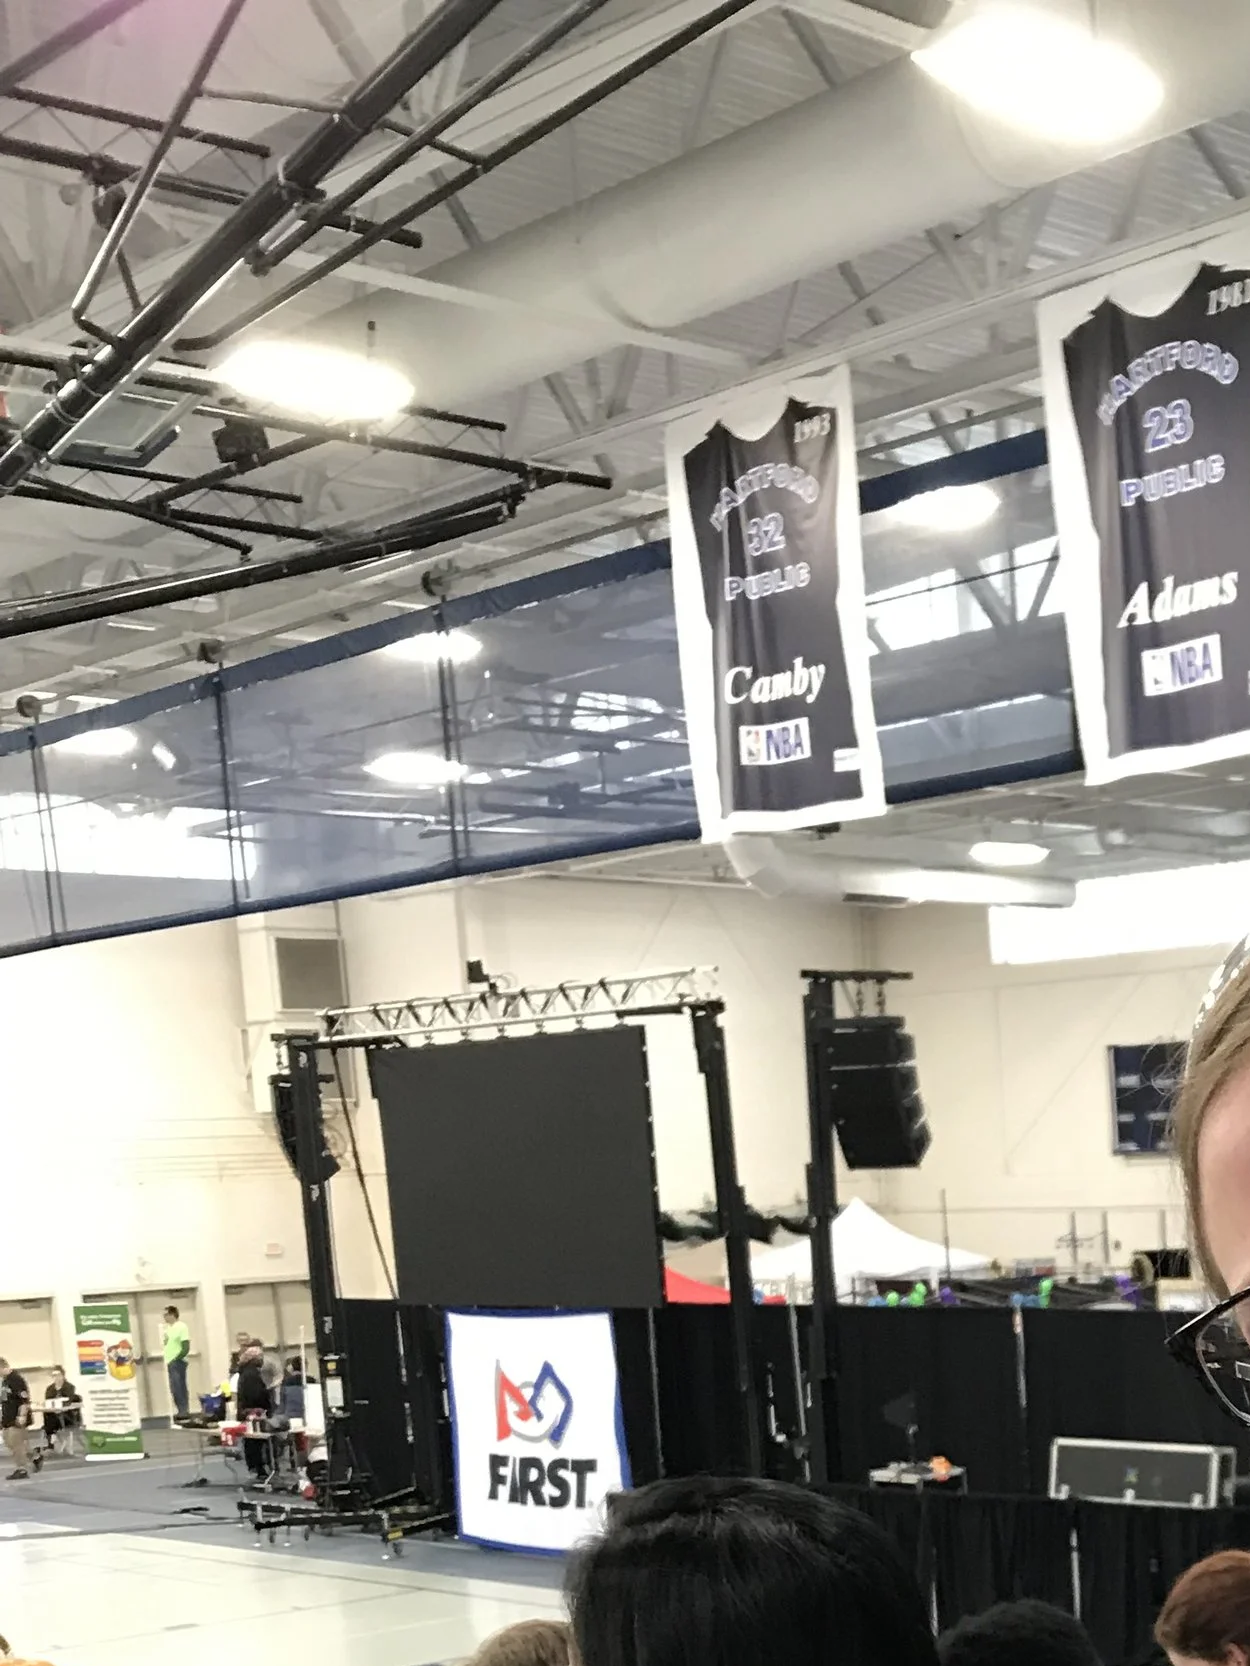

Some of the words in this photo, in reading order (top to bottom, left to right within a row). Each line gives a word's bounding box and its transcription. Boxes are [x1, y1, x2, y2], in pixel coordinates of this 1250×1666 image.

[1096, 339, 1240, 426] HARTFORD
[1142, 398, 1195, 453] 23
[709, 462, 820, 533] HARTFORD
[1118, 454, 1227, 507] PUBLIC
[747, 511, 787, 556] 32
[723, 561, 812, 601] PUBLIC
[1115, 571, 1239, 629] Adams
[724, 656, 826, 704] Camby
[1169, 642, 1214, 687] NBA
[765, 723, 804, 761] NBA
[488, 1453, 597, 1509] FIRST
